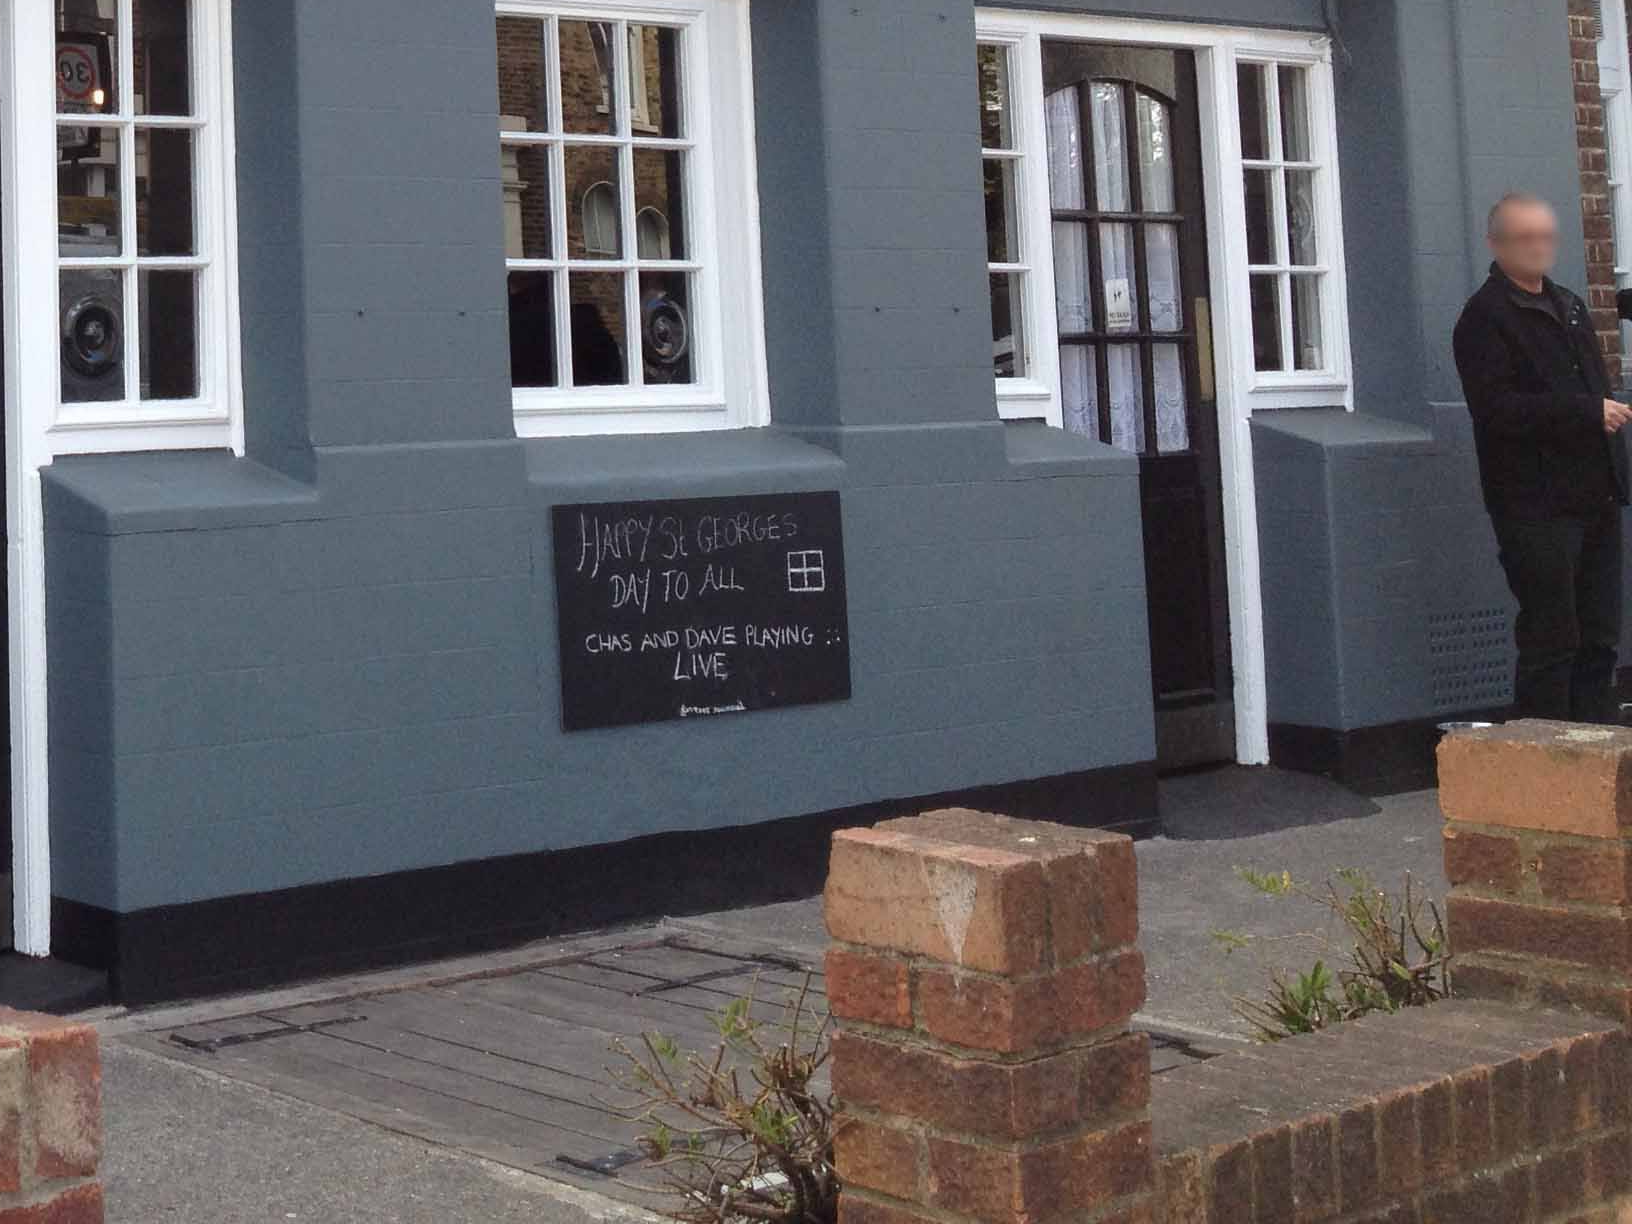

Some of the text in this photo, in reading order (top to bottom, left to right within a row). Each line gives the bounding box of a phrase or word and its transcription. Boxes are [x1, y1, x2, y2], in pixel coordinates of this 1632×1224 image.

[576, 512, 653, 579] HAPPY
[697, 511, 798, 553] GEORGES
[609, 563, 745, 615] DAY TO ALL
[585, 624, 814, 653] CHAS AND DAVE PLAYING
[673, 651, 729, 681] LIVE
